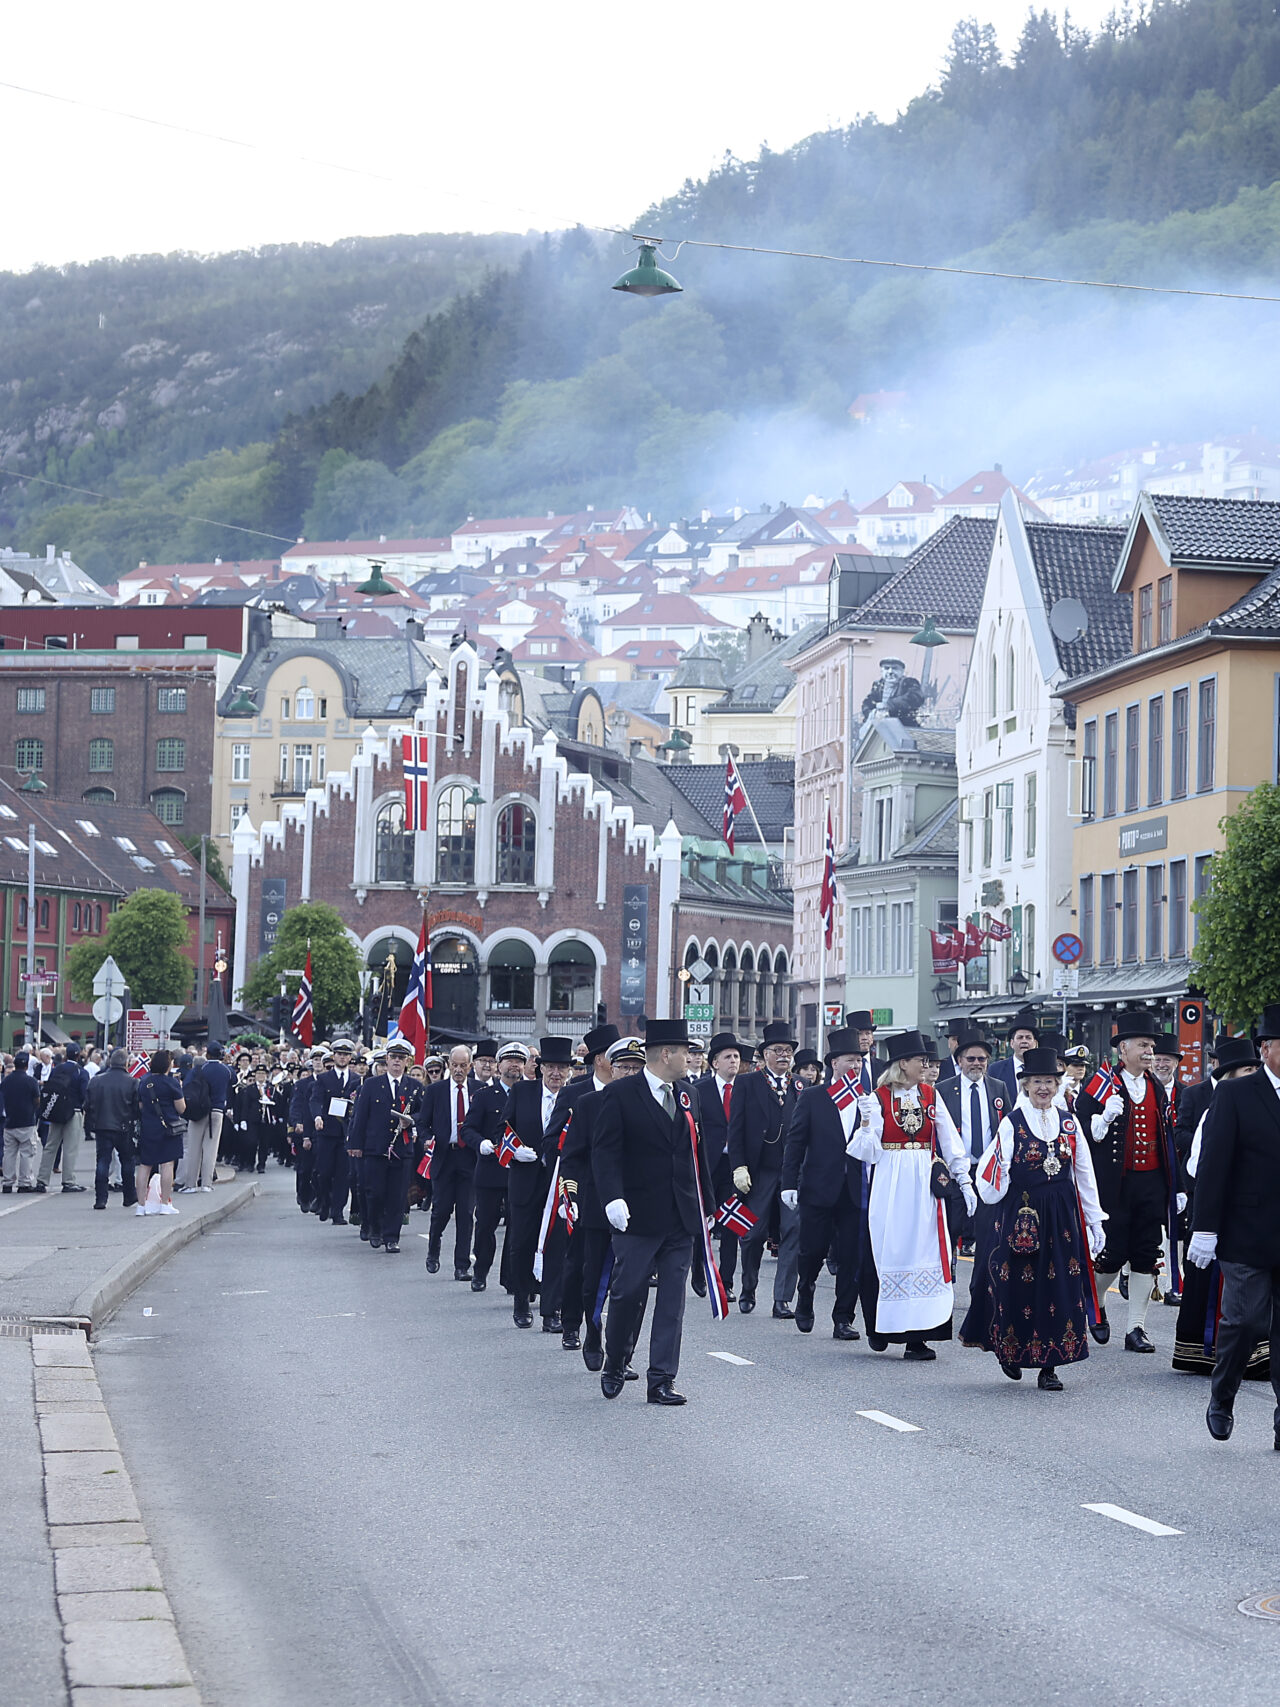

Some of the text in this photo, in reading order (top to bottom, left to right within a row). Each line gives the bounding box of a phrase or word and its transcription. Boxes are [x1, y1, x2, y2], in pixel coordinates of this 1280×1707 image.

[688, 1007, 710, 1017] E 39
[1186, 1008, 1197, 1021] C
[689, 1023, 709, 1033] 585
